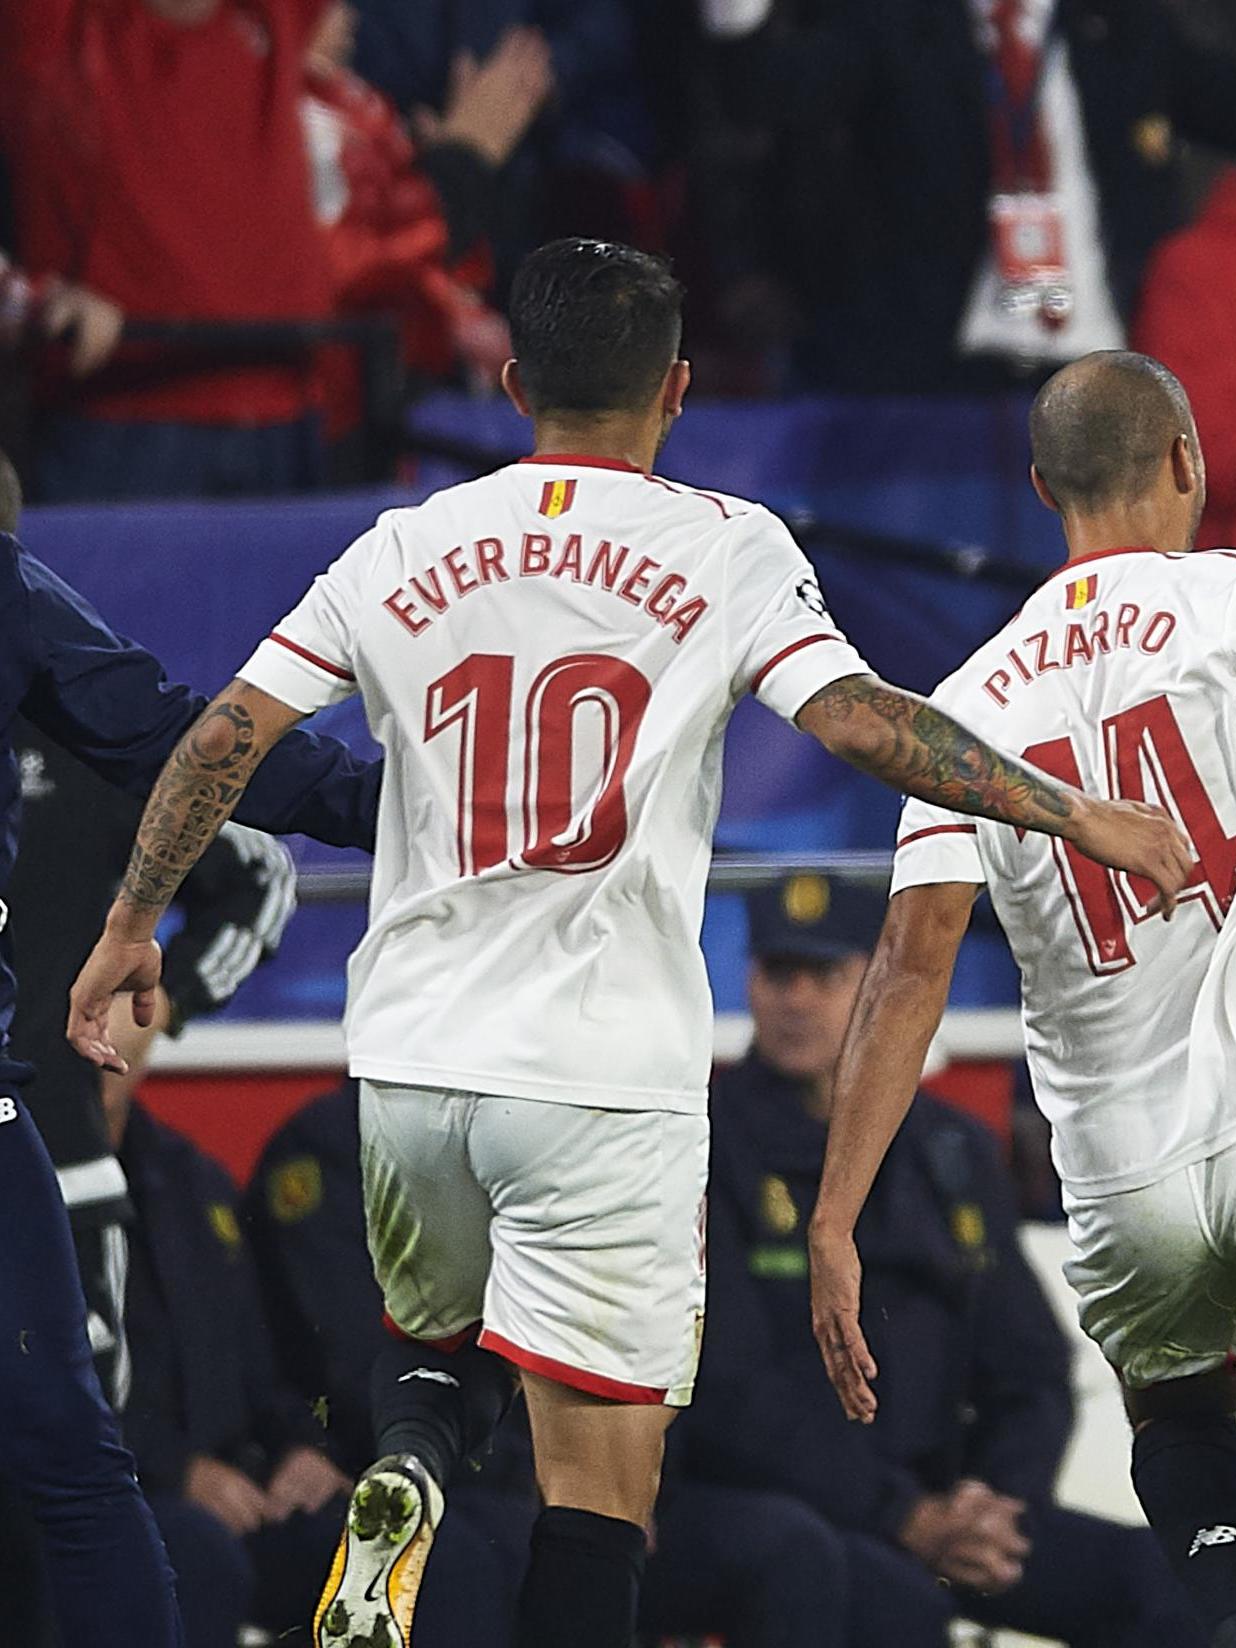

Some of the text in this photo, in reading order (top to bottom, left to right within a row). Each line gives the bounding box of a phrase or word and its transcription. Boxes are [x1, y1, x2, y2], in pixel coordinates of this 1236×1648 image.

[383, 533, 708, 644] EVER BANEGA
[982, 603, 1176, 709] PIZARRO
[424, 653, 652, 877] 10
